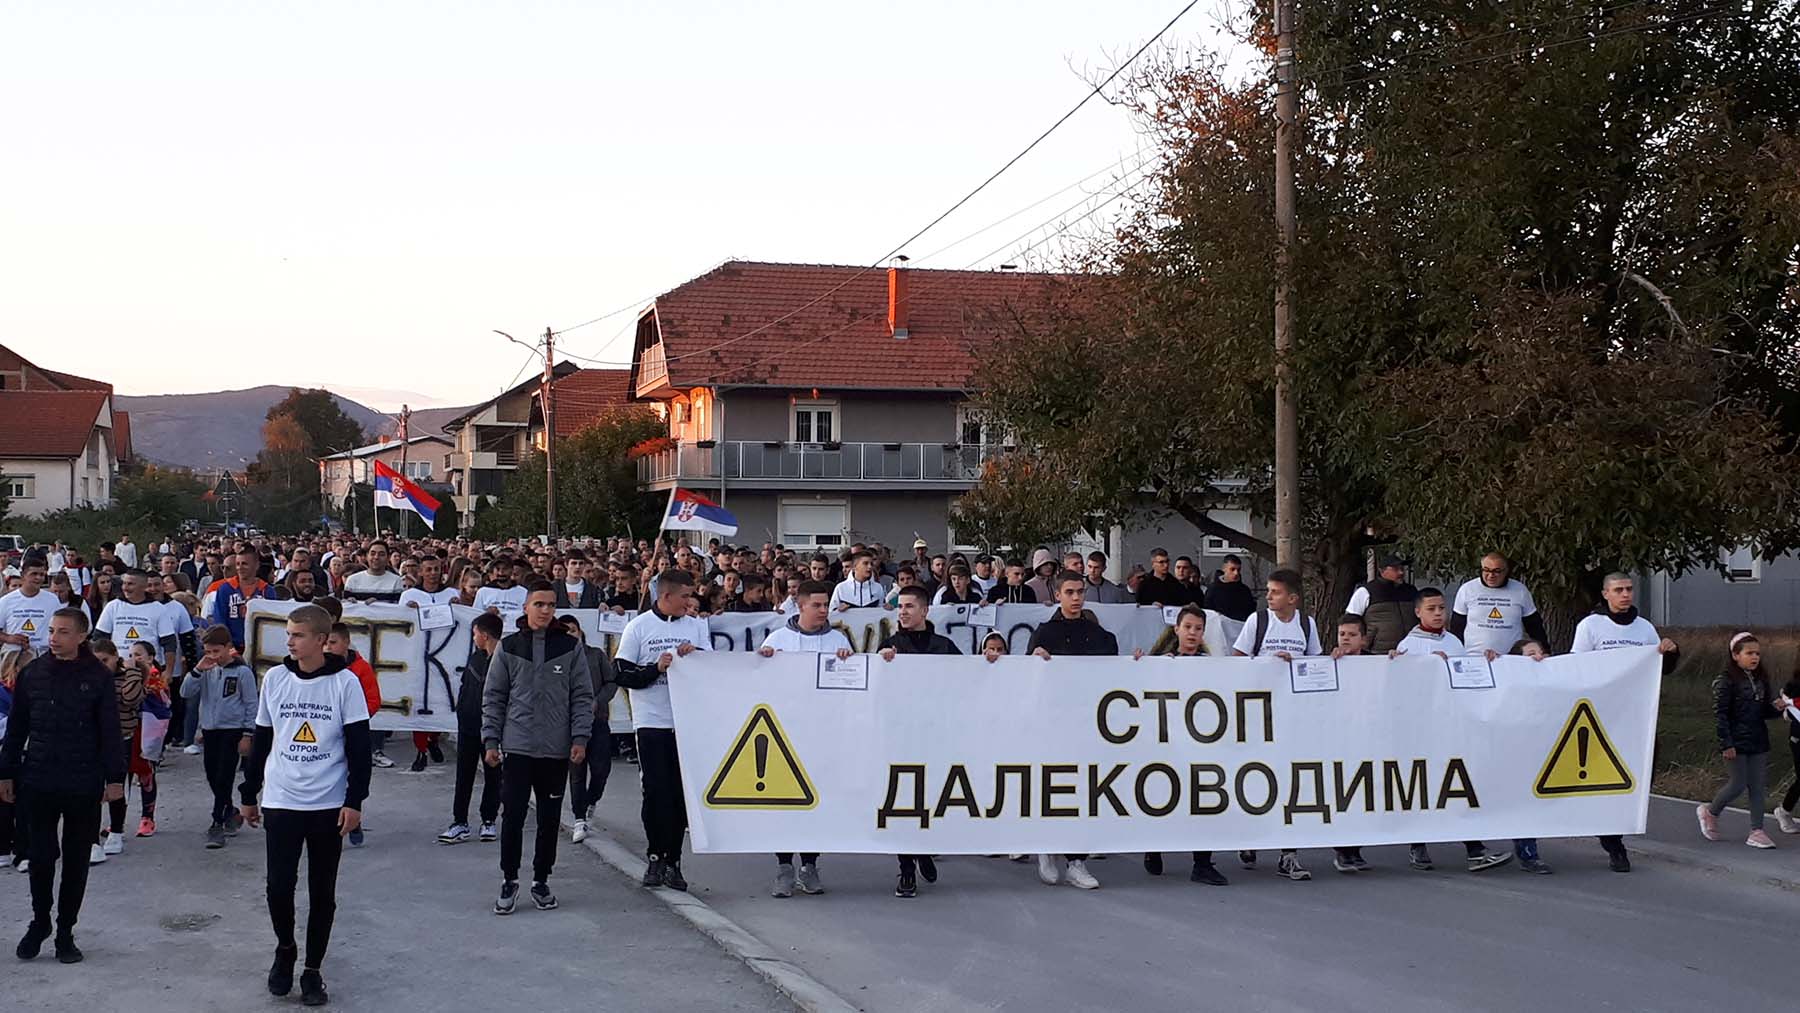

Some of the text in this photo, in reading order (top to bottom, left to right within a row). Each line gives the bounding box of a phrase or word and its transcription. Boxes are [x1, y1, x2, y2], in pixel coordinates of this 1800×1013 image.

[298, 703, 332, 712] NEPRAVDA
[1096, 690, 1275, 744] СТОП
[290, 744, 318, 752] OTPOR
[877, 757, 1481, 829] ДАЛЕКОВОДИМА
